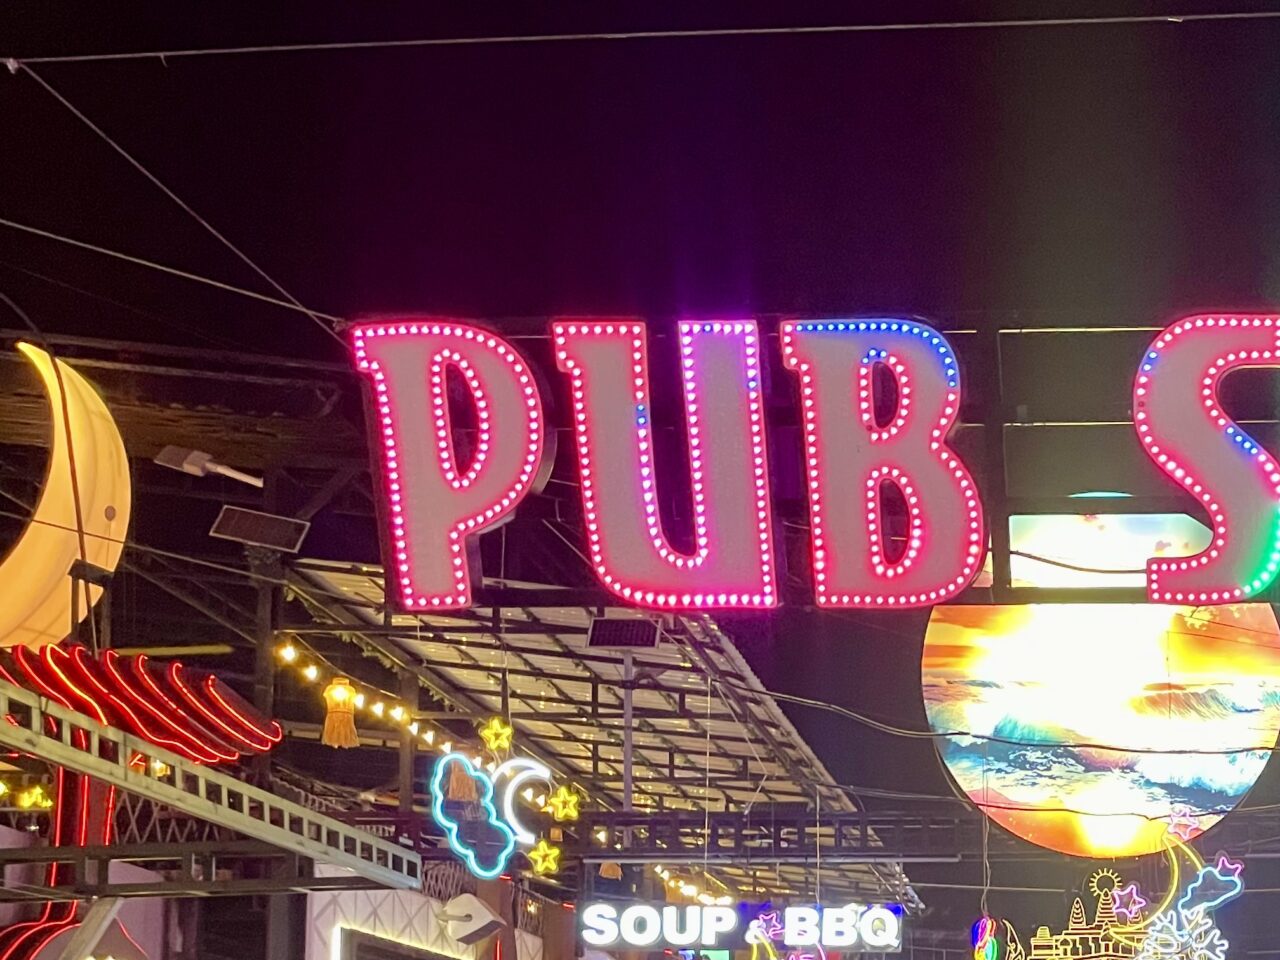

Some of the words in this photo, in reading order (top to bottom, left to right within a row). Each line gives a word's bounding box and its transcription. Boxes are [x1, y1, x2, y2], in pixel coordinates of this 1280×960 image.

[350, 316, 985, 608] PUB
[582, 902, 737, 946] SOUP
[784, 904, 900, 947] BBQ
